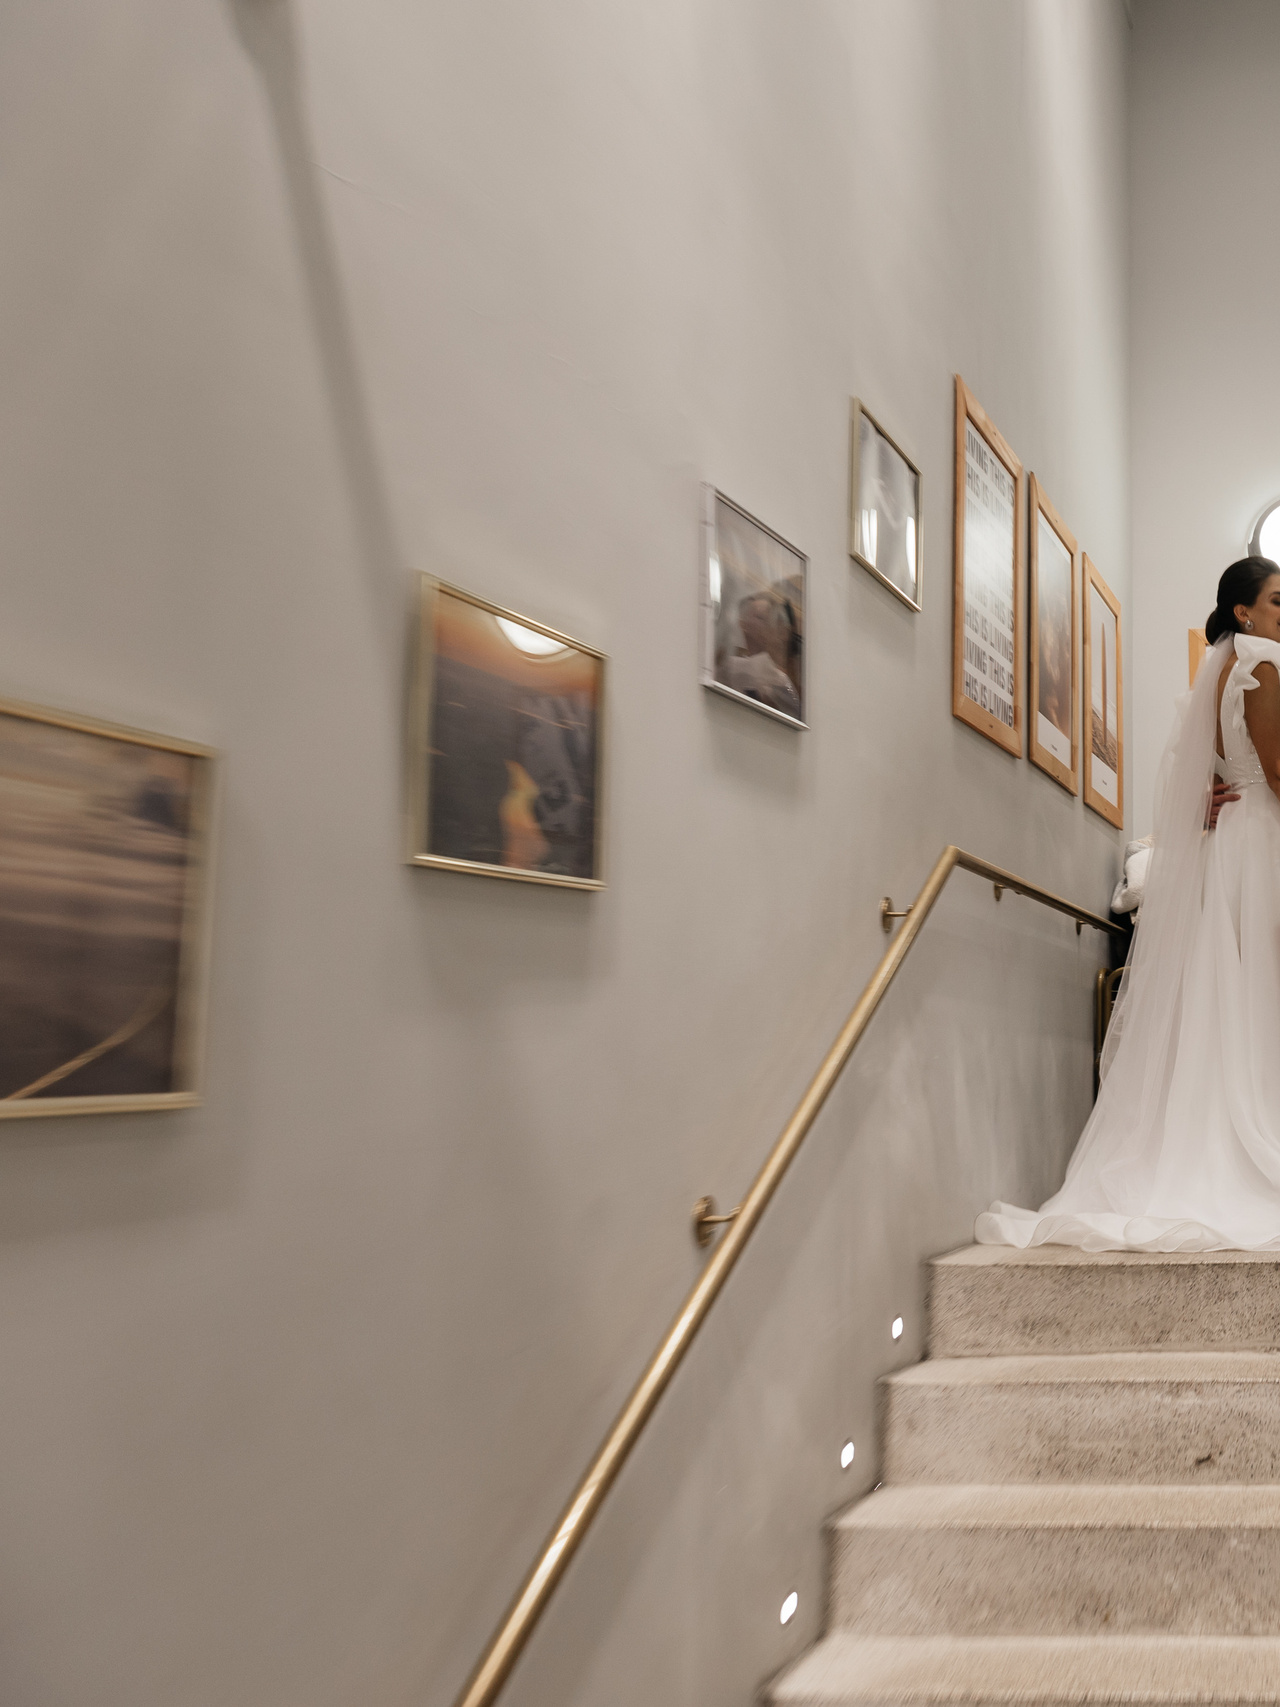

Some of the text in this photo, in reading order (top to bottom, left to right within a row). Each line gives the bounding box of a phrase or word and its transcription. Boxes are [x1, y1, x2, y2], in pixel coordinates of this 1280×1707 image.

[966, 429, 988, 475] IVING
[966, 462, 981, 499] HIS
[965, 600, 980, 634] HIS
[965, 636, 988, 675] IVING
[964, 670, 979, 702] HIS
